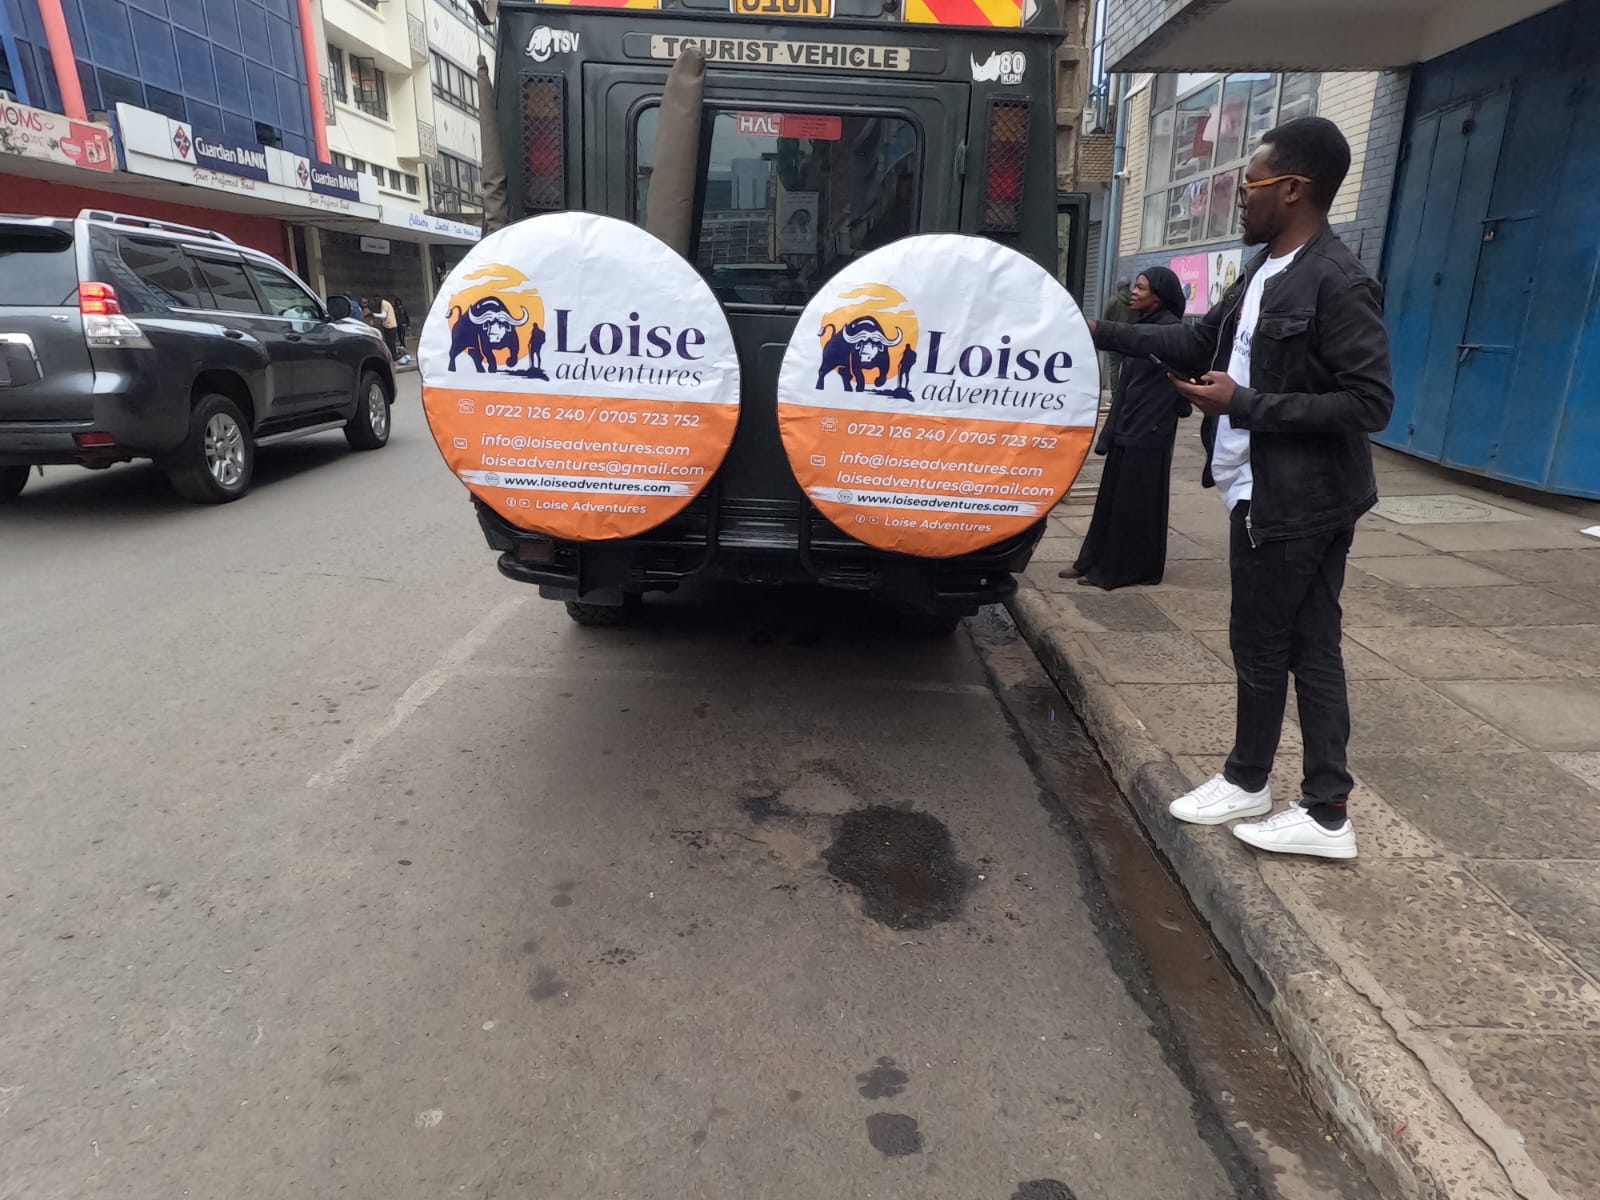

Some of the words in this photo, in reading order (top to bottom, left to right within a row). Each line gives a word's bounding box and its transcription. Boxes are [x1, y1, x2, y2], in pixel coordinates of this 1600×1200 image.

[550, 29, 580, 53] TSV
[787, 43, 899, 69] VEHICLE
[1000, 53, 1025, 74] 80
[1003, 73, 1021, 82] KPH
[194, 137, 237, 164] Guardian
[236, 147, 267, 170] BANK
[311, 168, 338, 187] Guardian
[338, 174, 359, 192] BANK
[553, 308, 706, 361] Loise
[923, 330, 1073, 384] Loise
[555, 357, 703, 388] adventures
[921, 380, 1066, 411] adventures
[484, 403, 522, 419] 0722
[527, 406, 551, 420] 126
[556, 408, 585, 422] 240
[587, 408, 597, 423] /
[599, 410, 637, 424] 0705
[642, 412, 669, 426] 723
[673, 414, 700, 428] 752
[481, 433, 690, 456] info@loiseadventures.com
[847, 422, 884, 437] 0722
[888, 425, 912, 439] 126
[915, 428, 946, 442] 240
[947, 429, 958, 443] /
[958, 431, 997, 445] 0705
[1001, 434, 1027, 447] 723
[1032, 436, 1058, 449] 752
[481, 454, 705, 476] loiseadventures@gmail.com
[839, 451, 1043, 477] info@loiseadventures.com
[504, 475, 671, 493] www.loiseadventures.com
[837, 471, 1055, 497] loiseadventures@gmail.com
[535, 499, 569, 511] Loise
[571, 501, 647, 514] Adventures
[857, 493, 1019, 513] www.loiseadventures.com
[884, 514, 917, 528] Loise
[919, 519, 992, 532] Adventures
